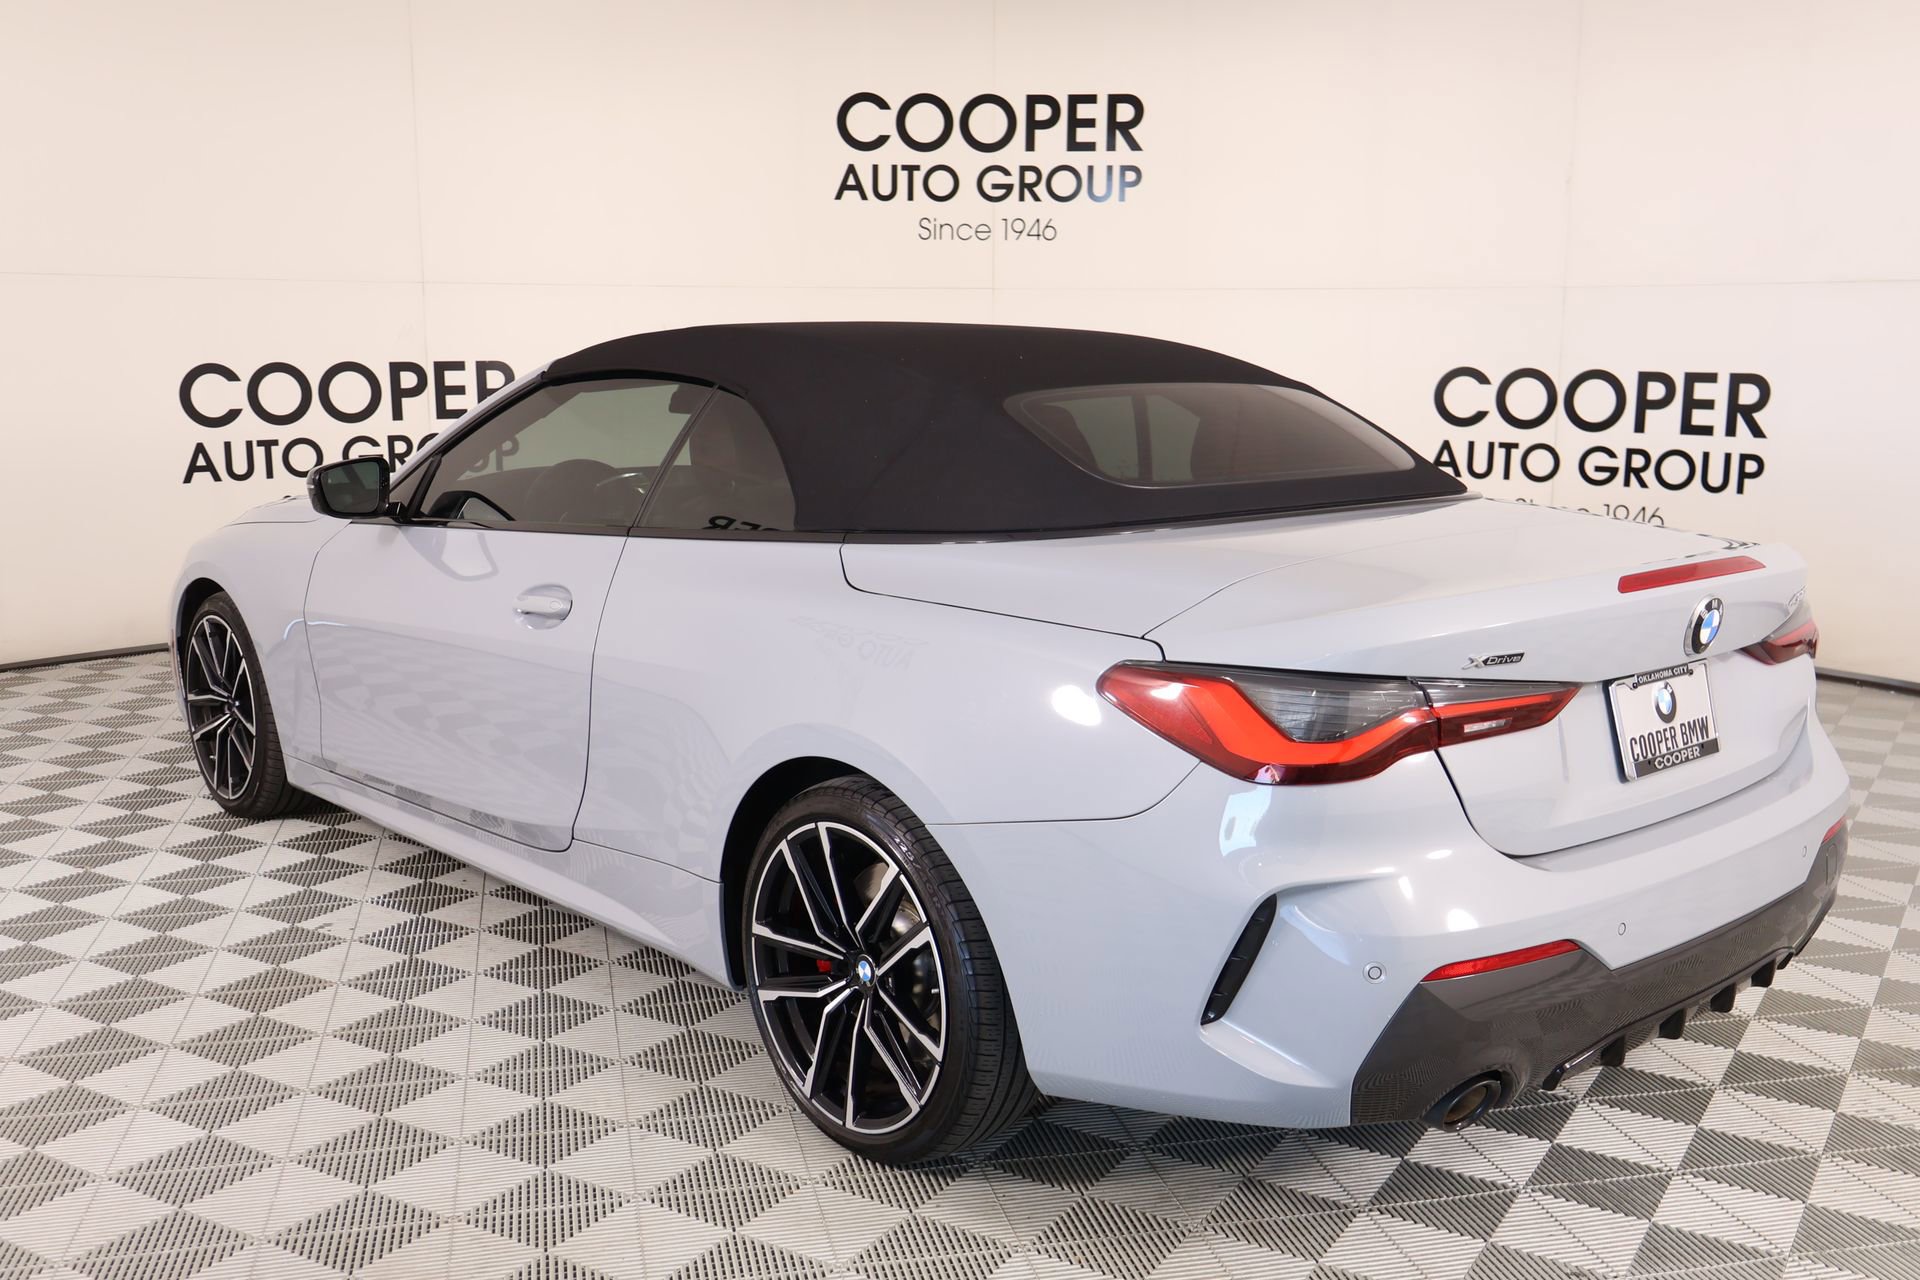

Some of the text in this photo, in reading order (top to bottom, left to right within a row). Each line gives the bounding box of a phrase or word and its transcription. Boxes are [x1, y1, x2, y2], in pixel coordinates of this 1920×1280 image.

[837, 92, 1144, 153] COOPER
[834, 164, 1142, 203] AUTO GROUP
[918, 217, 1058, 241] Since 1946
[179, 361, 515, 428] COOPER
[1434, 367, 1771, 438] COOPER
[183, 432, 520, 484] AUTO GRUP
[1433, 440, 1765, 494] AUTO GROUP
[1638, 666, 1689, 684] OKLAHOMA CITY
[1629, 716, 1710, 762] COOPER BMW
[1654, 746, 1701, 770] COOPER
